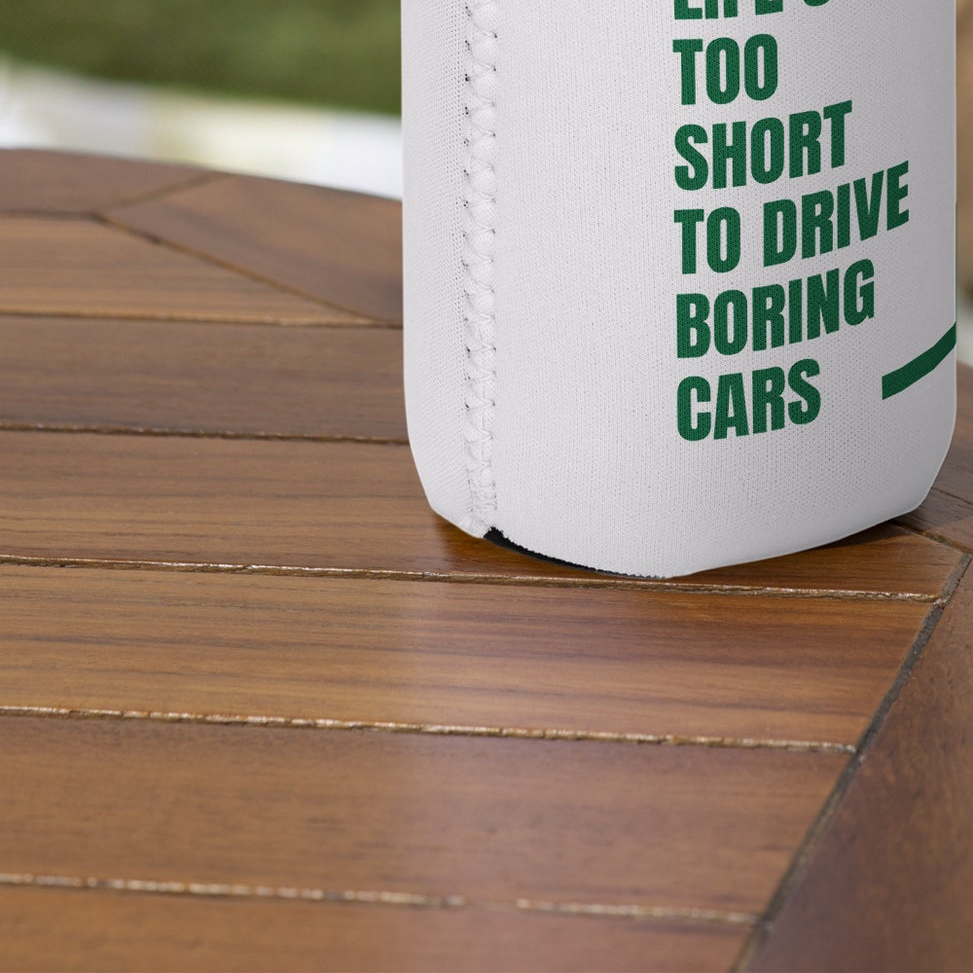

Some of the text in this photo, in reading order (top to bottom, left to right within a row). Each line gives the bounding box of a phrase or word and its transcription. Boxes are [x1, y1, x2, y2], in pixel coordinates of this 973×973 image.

[673, 34, 778, 106] TOO
[674, 100, 853, 191] SHORT
[674, 161, 909, 275] TO DRIVE
[676, 259, 875, 359] BORING
[677, 358, 821, 442] CARS
